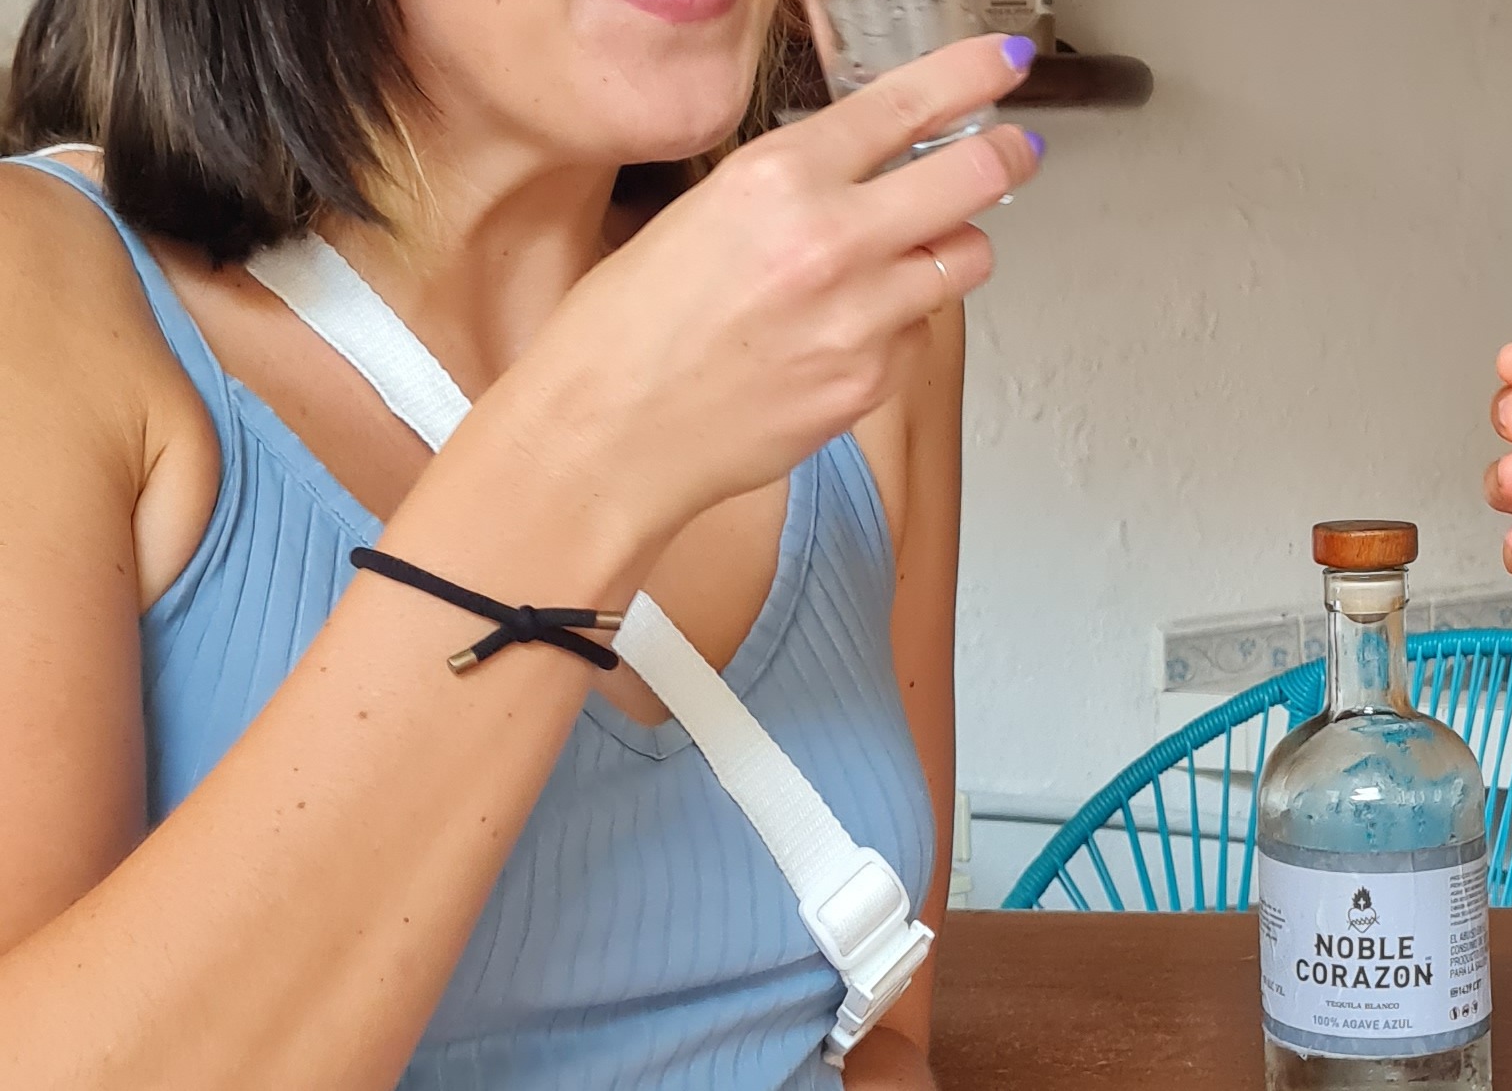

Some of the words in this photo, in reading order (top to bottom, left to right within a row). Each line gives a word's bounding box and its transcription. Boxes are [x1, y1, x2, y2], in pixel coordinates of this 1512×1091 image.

[1314, 933, 1415, 960] NOBLE
[1325, 1000, 1362, 1010] TEQUILA
[1365, 1001, 1400, 1010] BLANCO
[1312, 1014, 1340, 1028] 100%
[1342, 1018, 1380, 1030] AGAVE
[1383, 1019, 1413, 1030] AZUL
